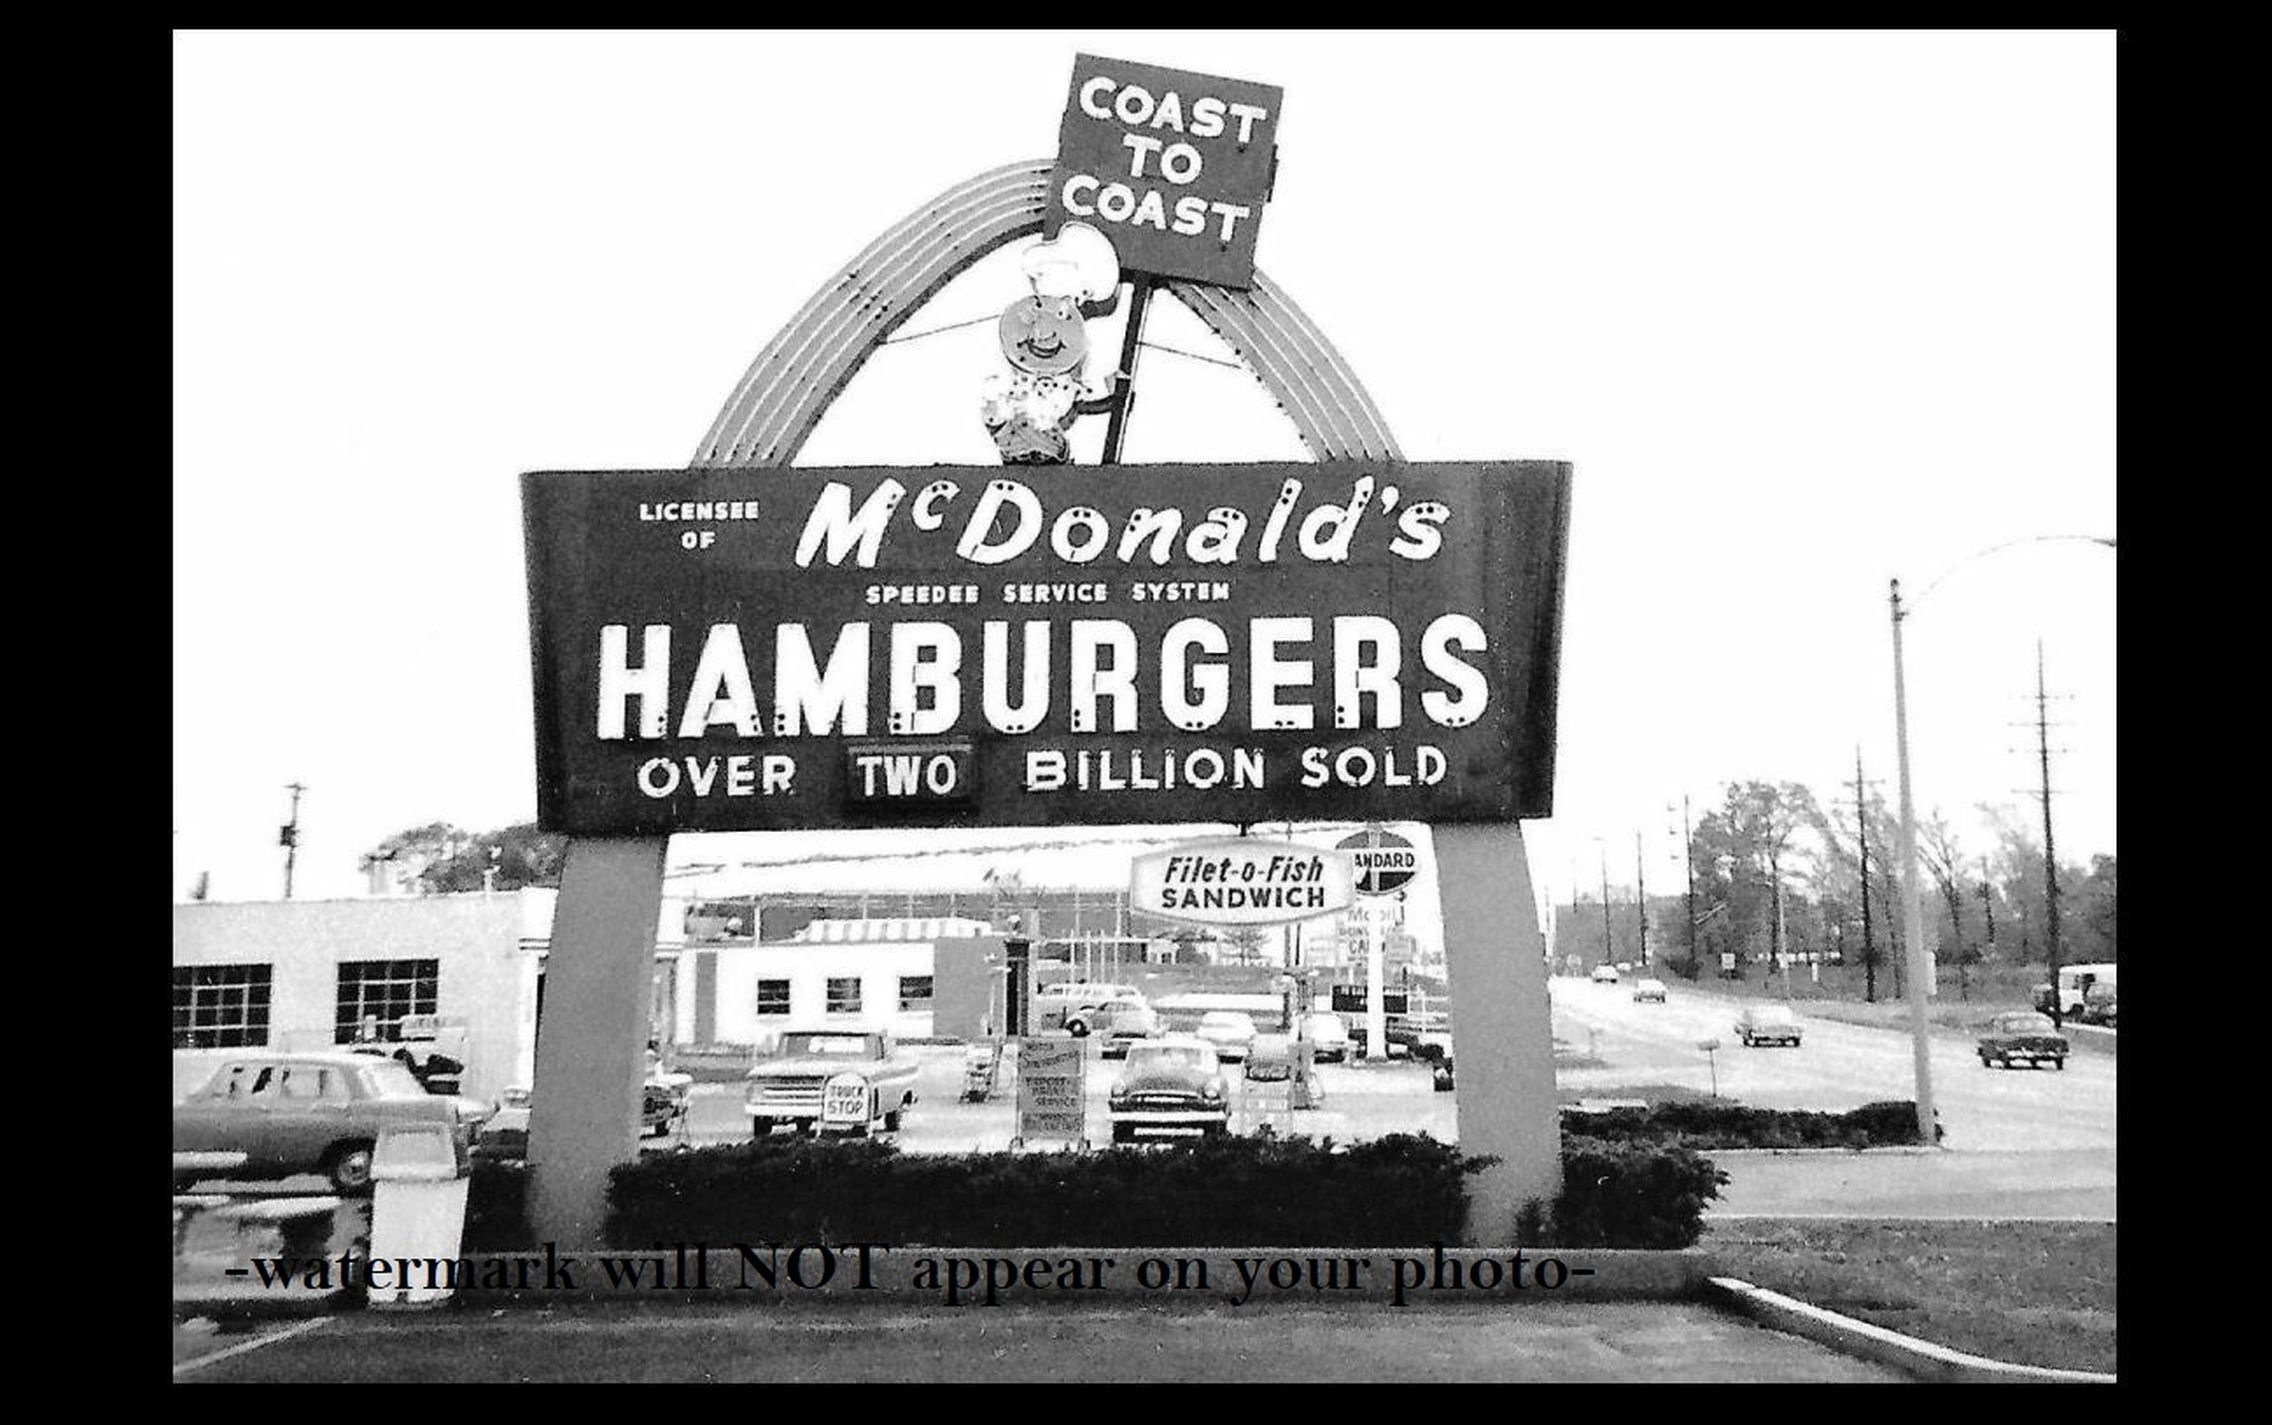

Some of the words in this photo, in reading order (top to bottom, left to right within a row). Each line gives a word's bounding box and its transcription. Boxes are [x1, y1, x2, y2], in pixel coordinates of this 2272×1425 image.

[1079, 76, 1268, 144] COAST
[1122, 132, 1203, 185] TO
[1061, 174, 1250, 242] COAST
[640, 501, 759, 521] LICENSEE
[795, 475, 1451, 568] McDonald's
[681, 531, 716, 550] OF
[865, 585, 979, 605] SPEEDEE
[1003, 583, 1108, 603] SERVICE
[1132, 582, 1230, 602] SYSTEM
[597, 613, 1489, 740] HAMBURGERS
[637, 755, 797, 798] OVER
[856, 754, 957, 796] TWO
[1026, 748, 1264, 792] BILLION
[1301, 745, 1447, 788] SOLD
[1164, 855, 1324, 884] Filet-o-Fish
[1161, 886, 1325, 909] SANDWICH
[828, 1100, 864, 1115] STOP
